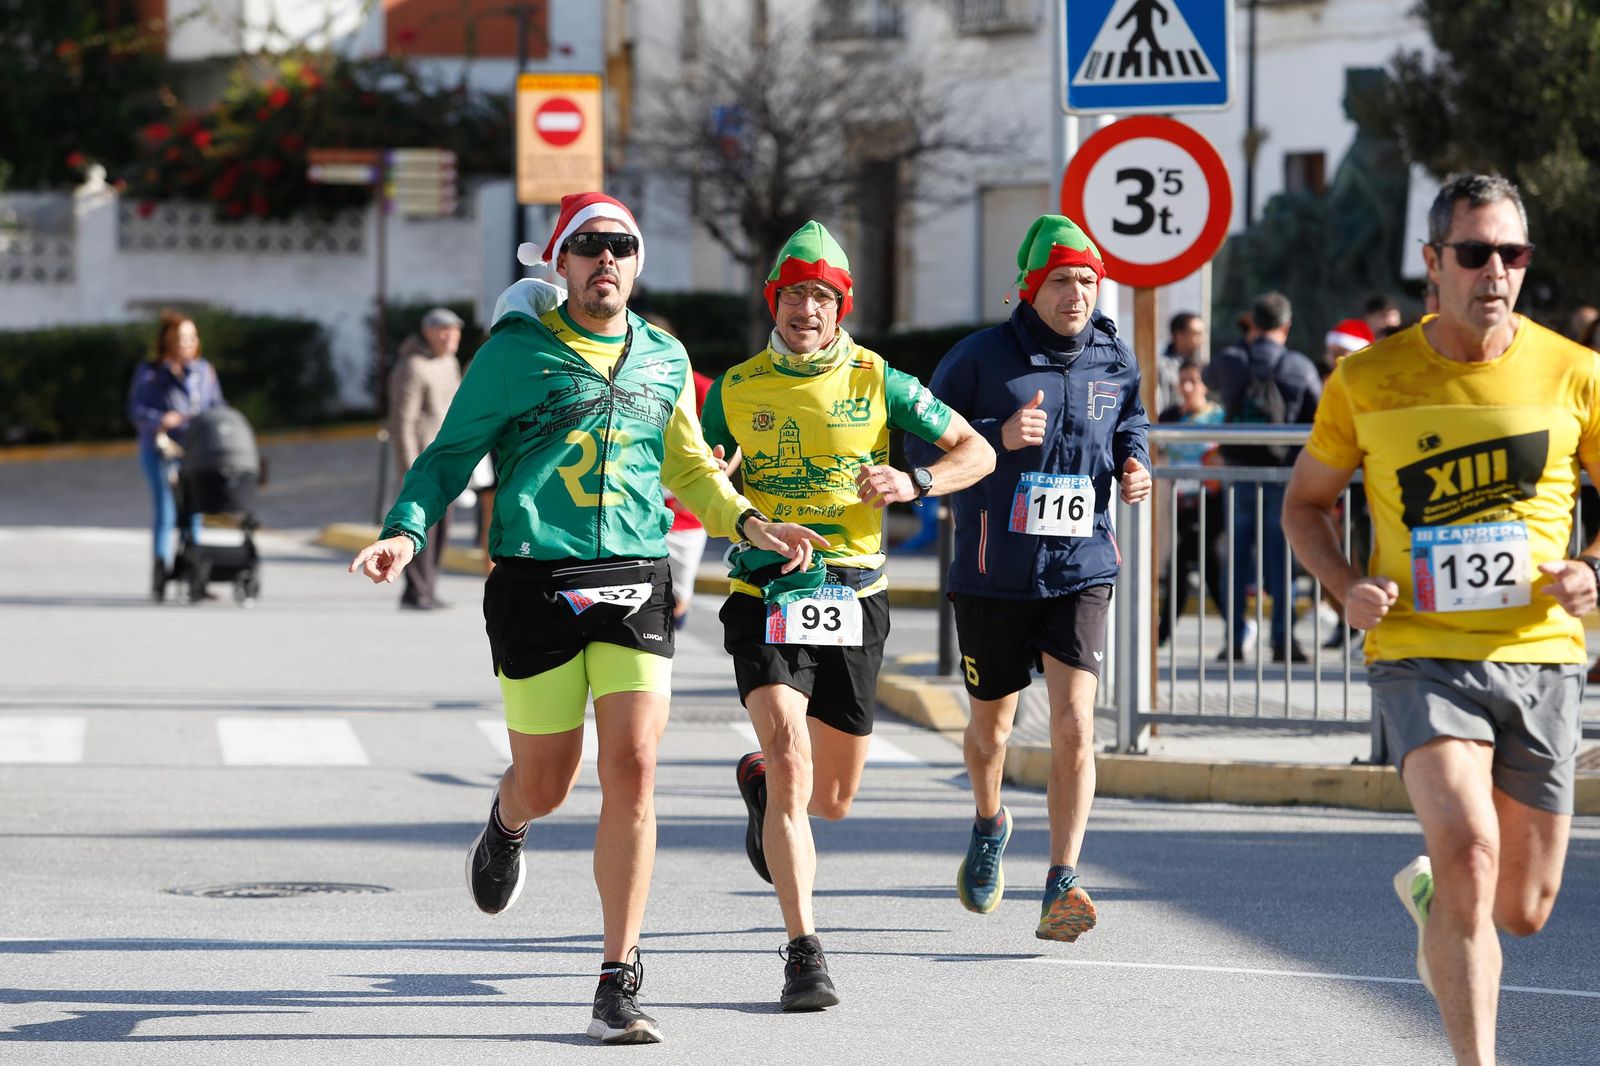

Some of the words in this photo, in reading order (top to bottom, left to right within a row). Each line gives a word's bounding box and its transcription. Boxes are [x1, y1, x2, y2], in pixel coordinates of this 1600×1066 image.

[1424, 449, 1508, 502] XIII
[1034, 494, 1085, 521] 116
[1441, 552, 1516, 589] 132
[599, 588, 642, 601] 52
[802, 604, 842, 631] 93
